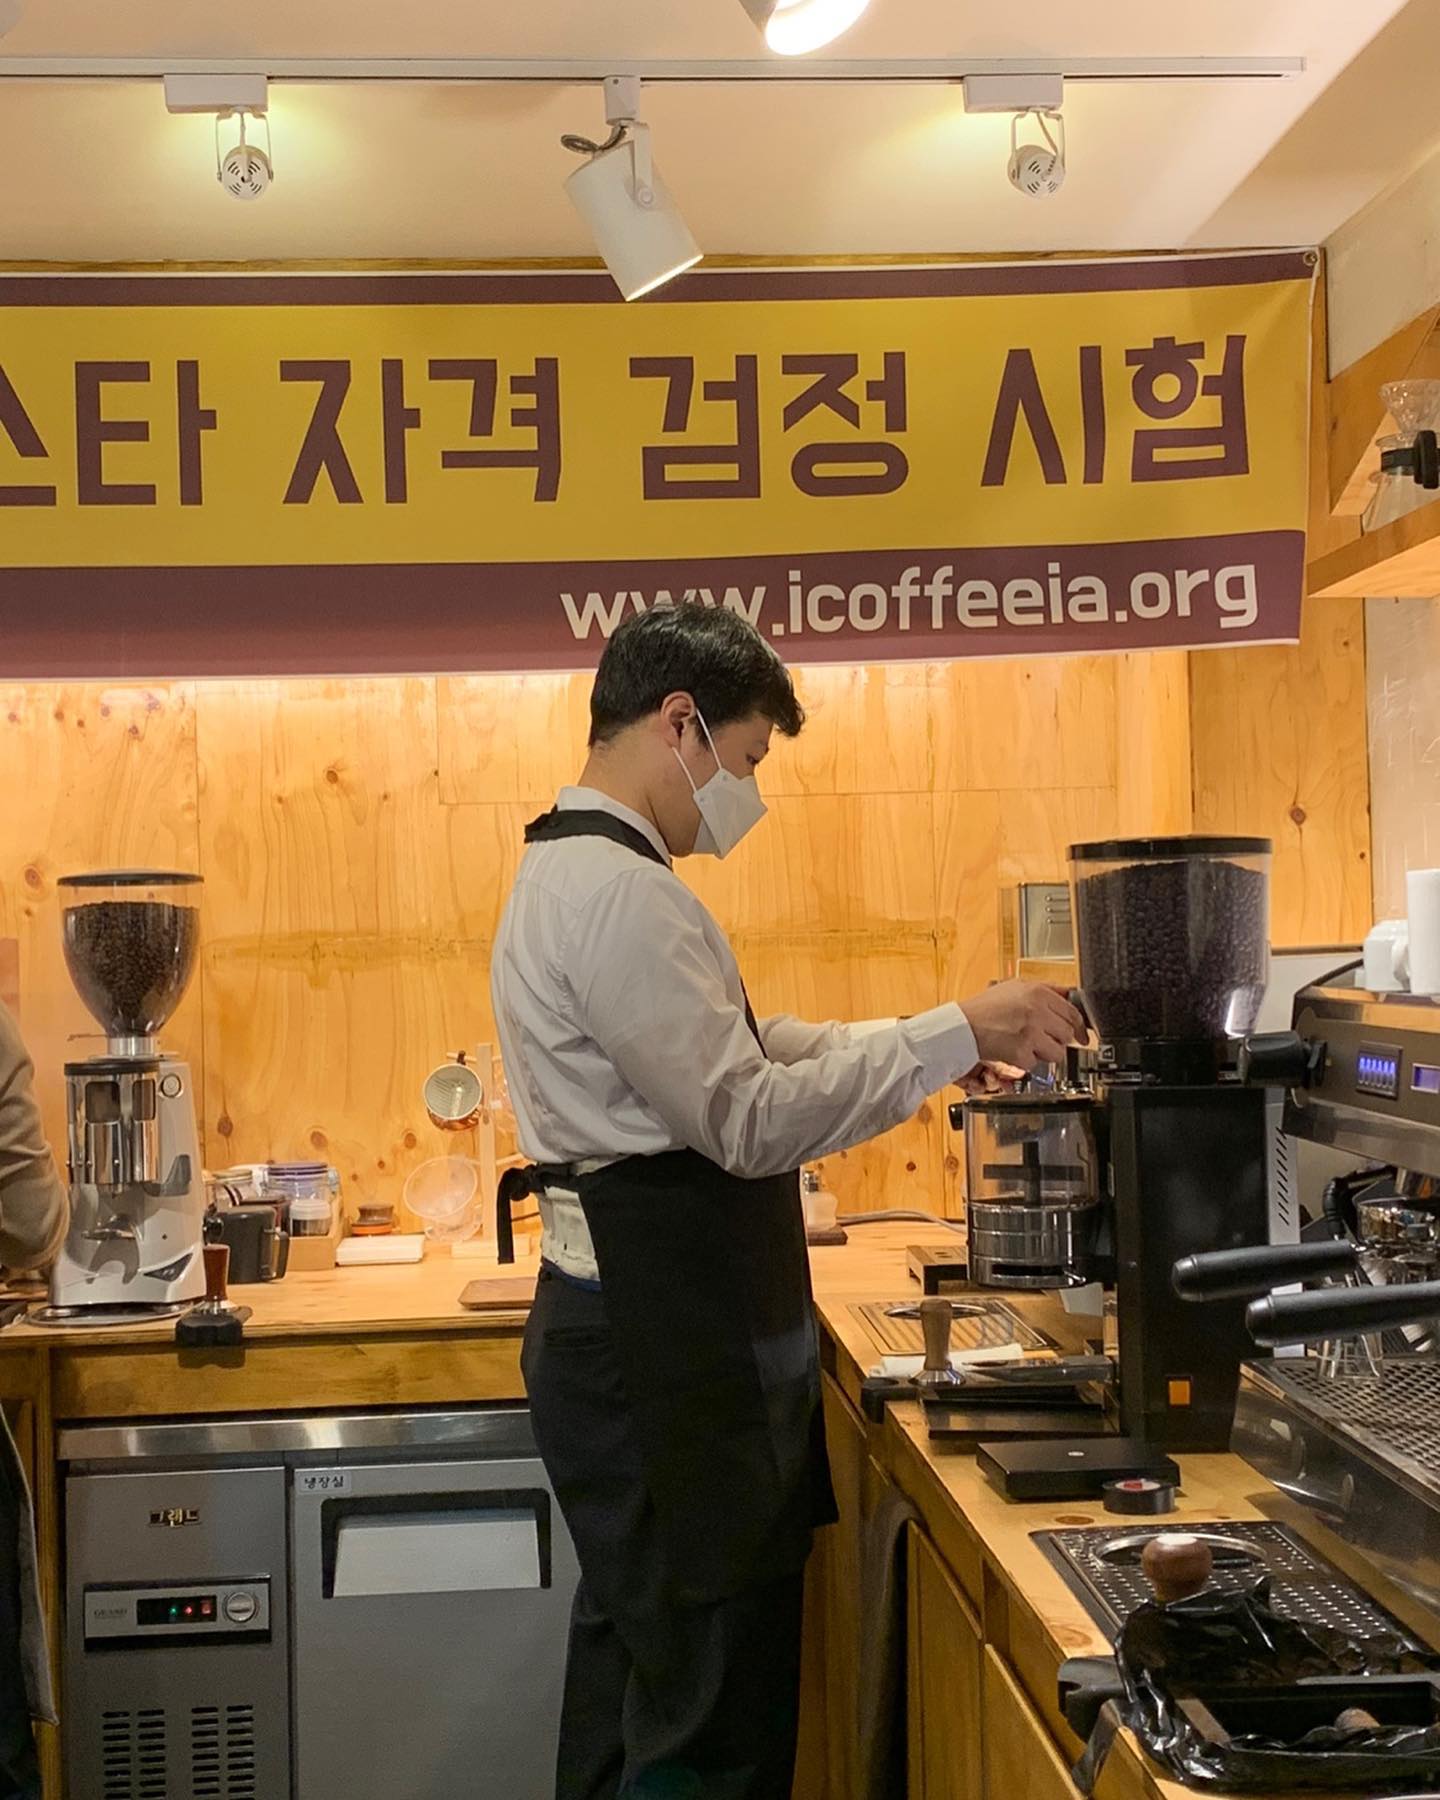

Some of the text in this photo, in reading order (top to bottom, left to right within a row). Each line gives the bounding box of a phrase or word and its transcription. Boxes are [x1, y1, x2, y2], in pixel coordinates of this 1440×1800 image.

[279, 357, 562, 505] 자격
[628, 351, 910, 501] 검정
[980, 334, 1250, 488] 시험
[304, 1475, 344, 1490] 냉장실
